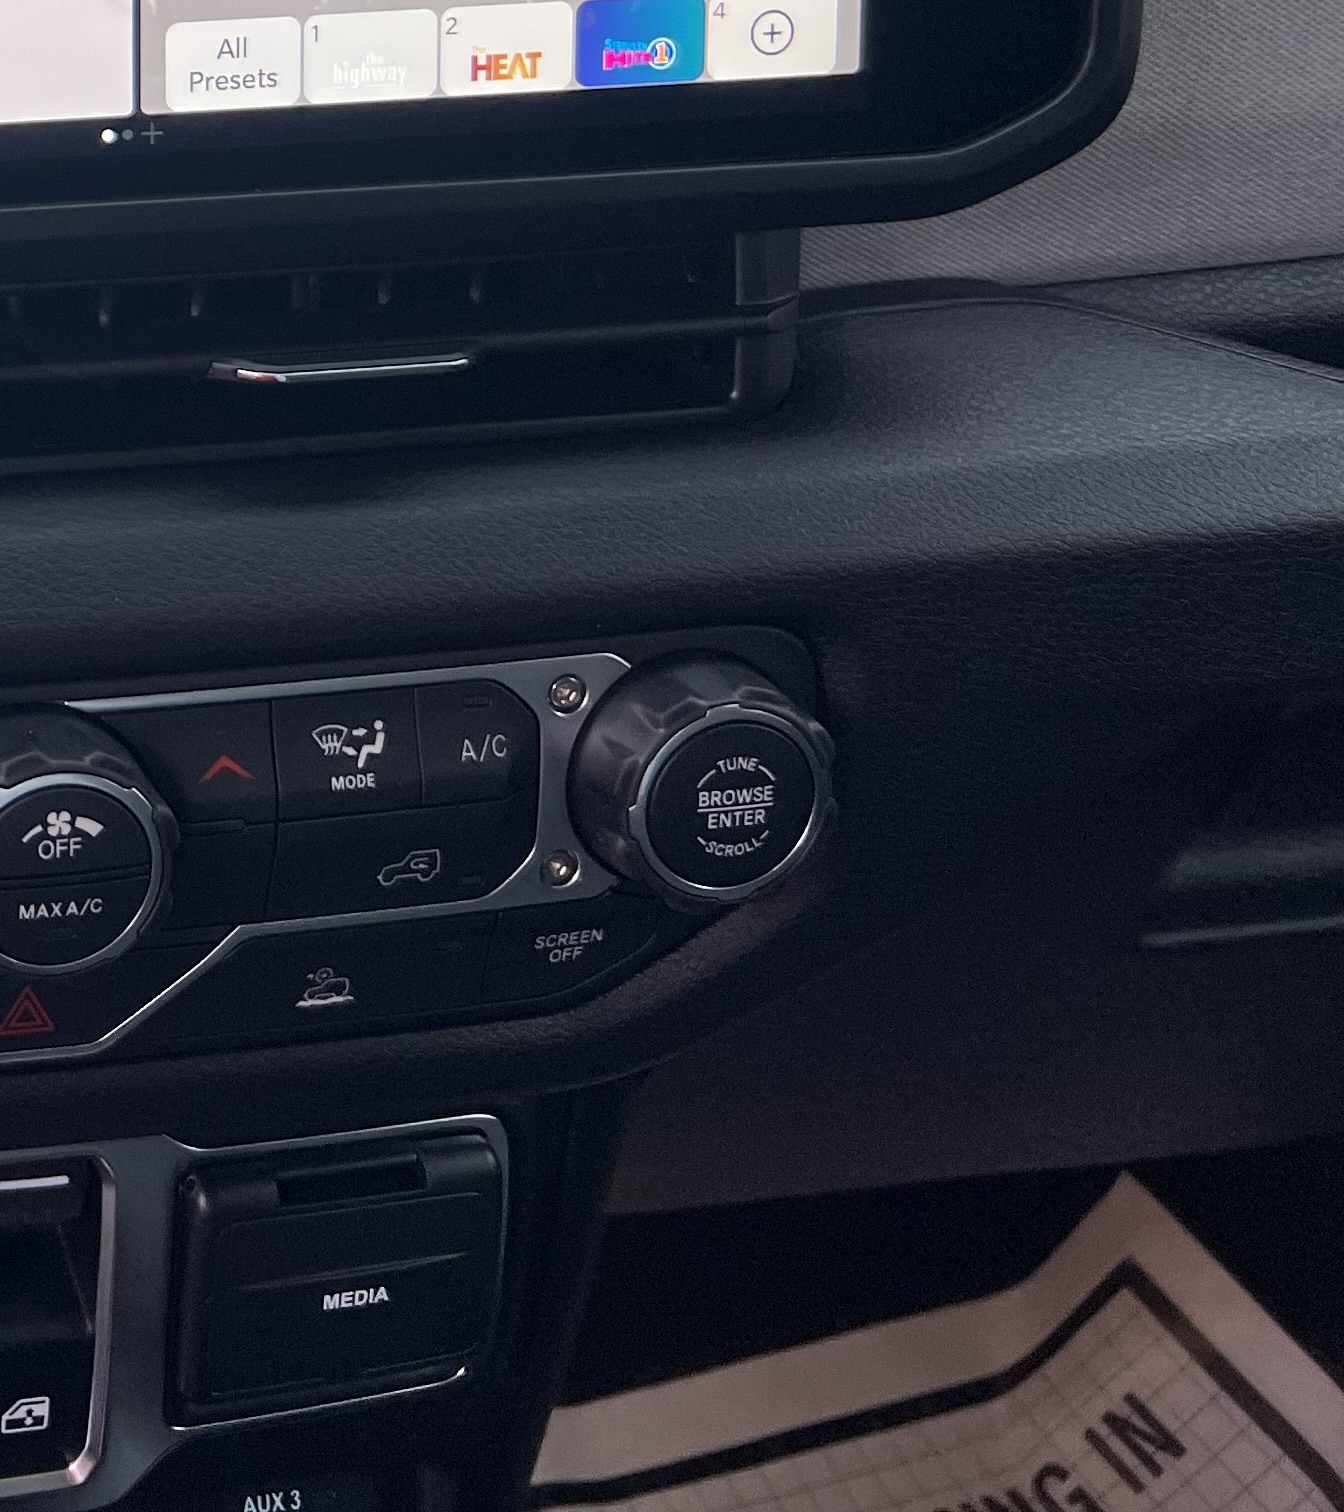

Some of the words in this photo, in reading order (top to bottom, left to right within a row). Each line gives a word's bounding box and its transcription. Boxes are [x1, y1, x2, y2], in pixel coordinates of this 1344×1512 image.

[713, 2, 726, 19] 4
[311, 24, 320, 42] 1
[445, 16, 459, 35] 2
[216, 37, 248, 59] All
[332, 61, 408, 88] highway
[470, 51, 543, 82] HEAT
[189, 69, 278, 92] Presets
[460, 733, 508, 763] A/C
[716, 756, 759, 774] TUNE
[331, 772, 377, 791] MODE
[697, 785, 775, 808] BROWSE
[707, 808, 767, 829] ENTER
[37, 836, 83, 861] OFF
[705, 838, 765, 857] SCROLL
[18, 901, 63, 920] MAX
[65, 897, 104, 916] A/C
[534, 929, 604, 950] SCREEN
[548, 946, 584, 963] OFF
[321, 1286, 390, 1311] MEDIA
[1084, 1392, 1188, 1495] IN
[243, 1491, 286, 1512] AUX
[290, 1489, 302, 1510] 3
